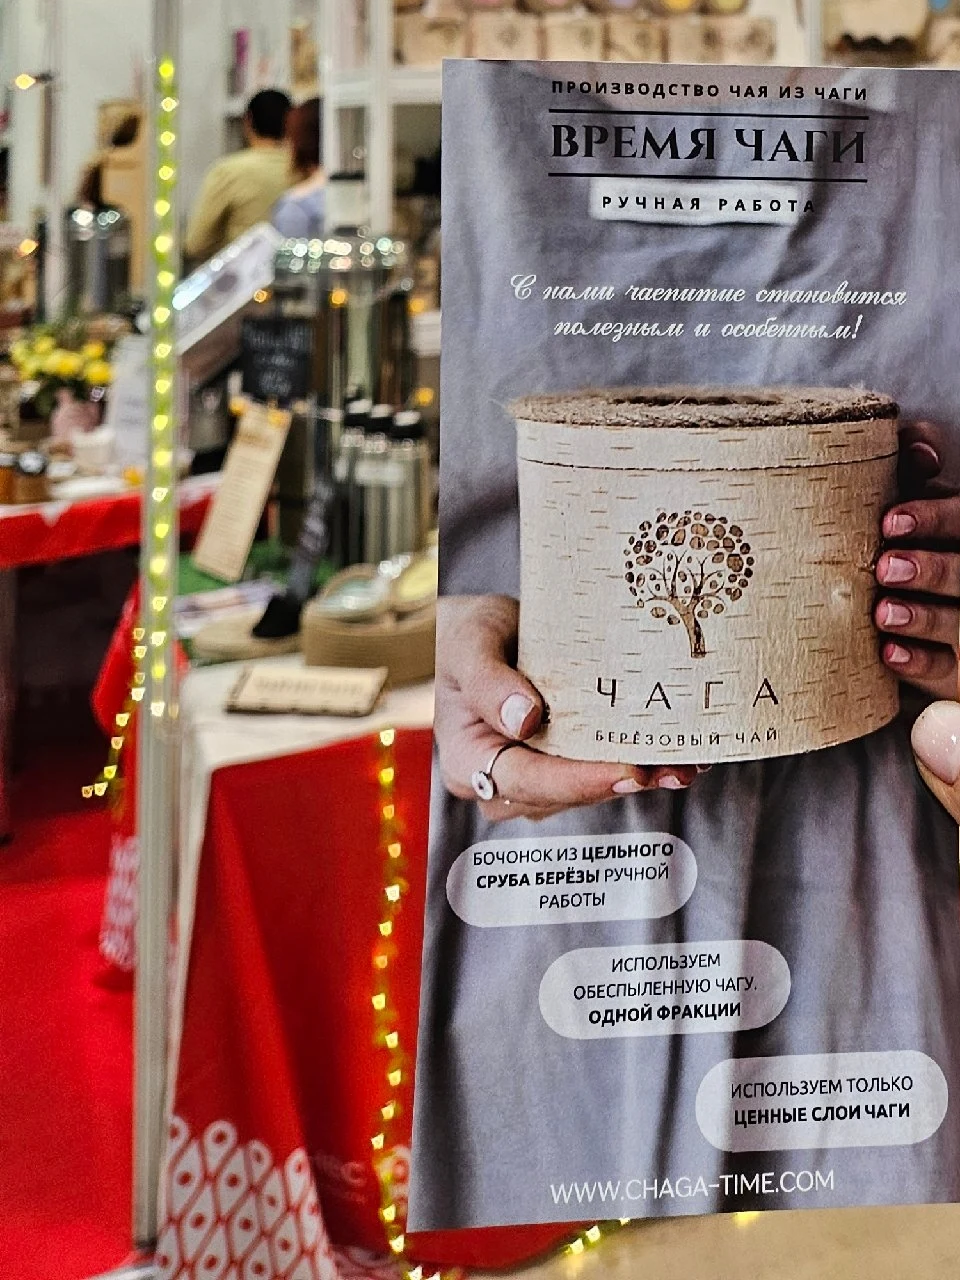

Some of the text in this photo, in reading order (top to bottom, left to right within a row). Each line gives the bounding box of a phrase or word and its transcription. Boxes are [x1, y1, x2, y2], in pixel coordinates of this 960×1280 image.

[550, 80, 868, 103] ПРОИЗВОДСТВО ЧАЯ ИЗ ЧАГИ
[550, 124, 867, 165] ВРЕМЯ ЧАГИ
[601, 195, 816, 214] РУЧНАЯ РАБОТА
[509, 274, 909, 307] С нами чаепитие становится
[553, 314, 864, 343] полезным и особенным!
[596, 677, 779, 710] ЧАГА
[594, 726, 780, 747] БЕРЁЗОВЫЙ ЧАЙ
[471, 842, 675, 866] БОЧОНОК ИЗ ЦЕЛЬНОГО
[475, 861, 670, 889] СРУБА БЕРЁЗЫ РУЧНОЙ
[538, 892, 606, 910] РАБОТЫ
[611, 953, 721, 974] ИСПОЛЬЗУЕМ
[572, 975, 758, 1001] ОБЕСПЫЛЕННУЮ ЧАГУ.
[588, 1001, 742, 1028] ОДНОЙ ФРАКЦИИ
[730, 1075, 914, 1100] ИСПОЛЬЗУЕМ ТОЛЬКО
[733, 1101, 911, 1128] ЦЕННЫЕ СЛОИ ЧАГИ
[548, 1169, 836, 1206] WWW.CHAGA-TIME.COM
